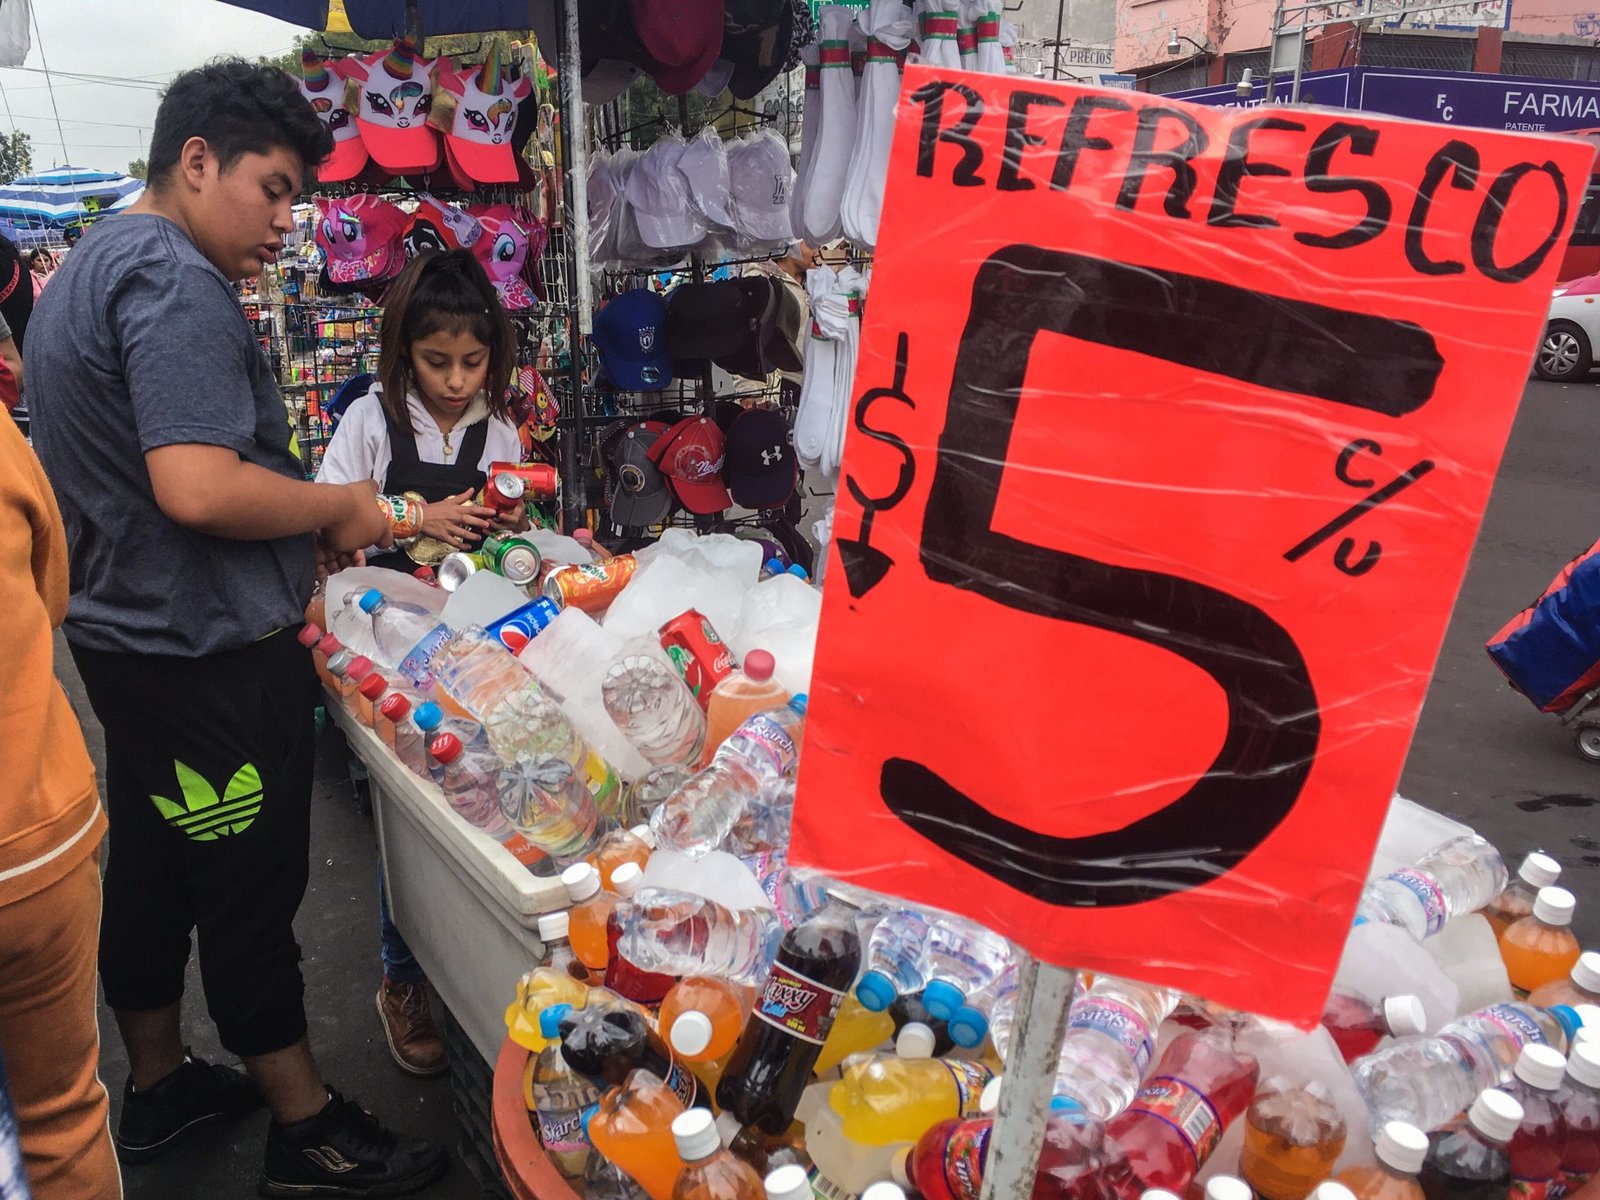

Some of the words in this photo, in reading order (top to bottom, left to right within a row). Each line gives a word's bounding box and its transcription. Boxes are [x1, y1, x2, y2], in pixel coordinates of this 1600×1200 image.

[1070, 50, 1112, 65] PRECIOS
[1503, 91, 1600, 119] FARMA
[1504, 122, 1546, 132] PATENTE
[910, 80, 1569, 284] REFRESCO
[880, 244, 1444, 908] 5
